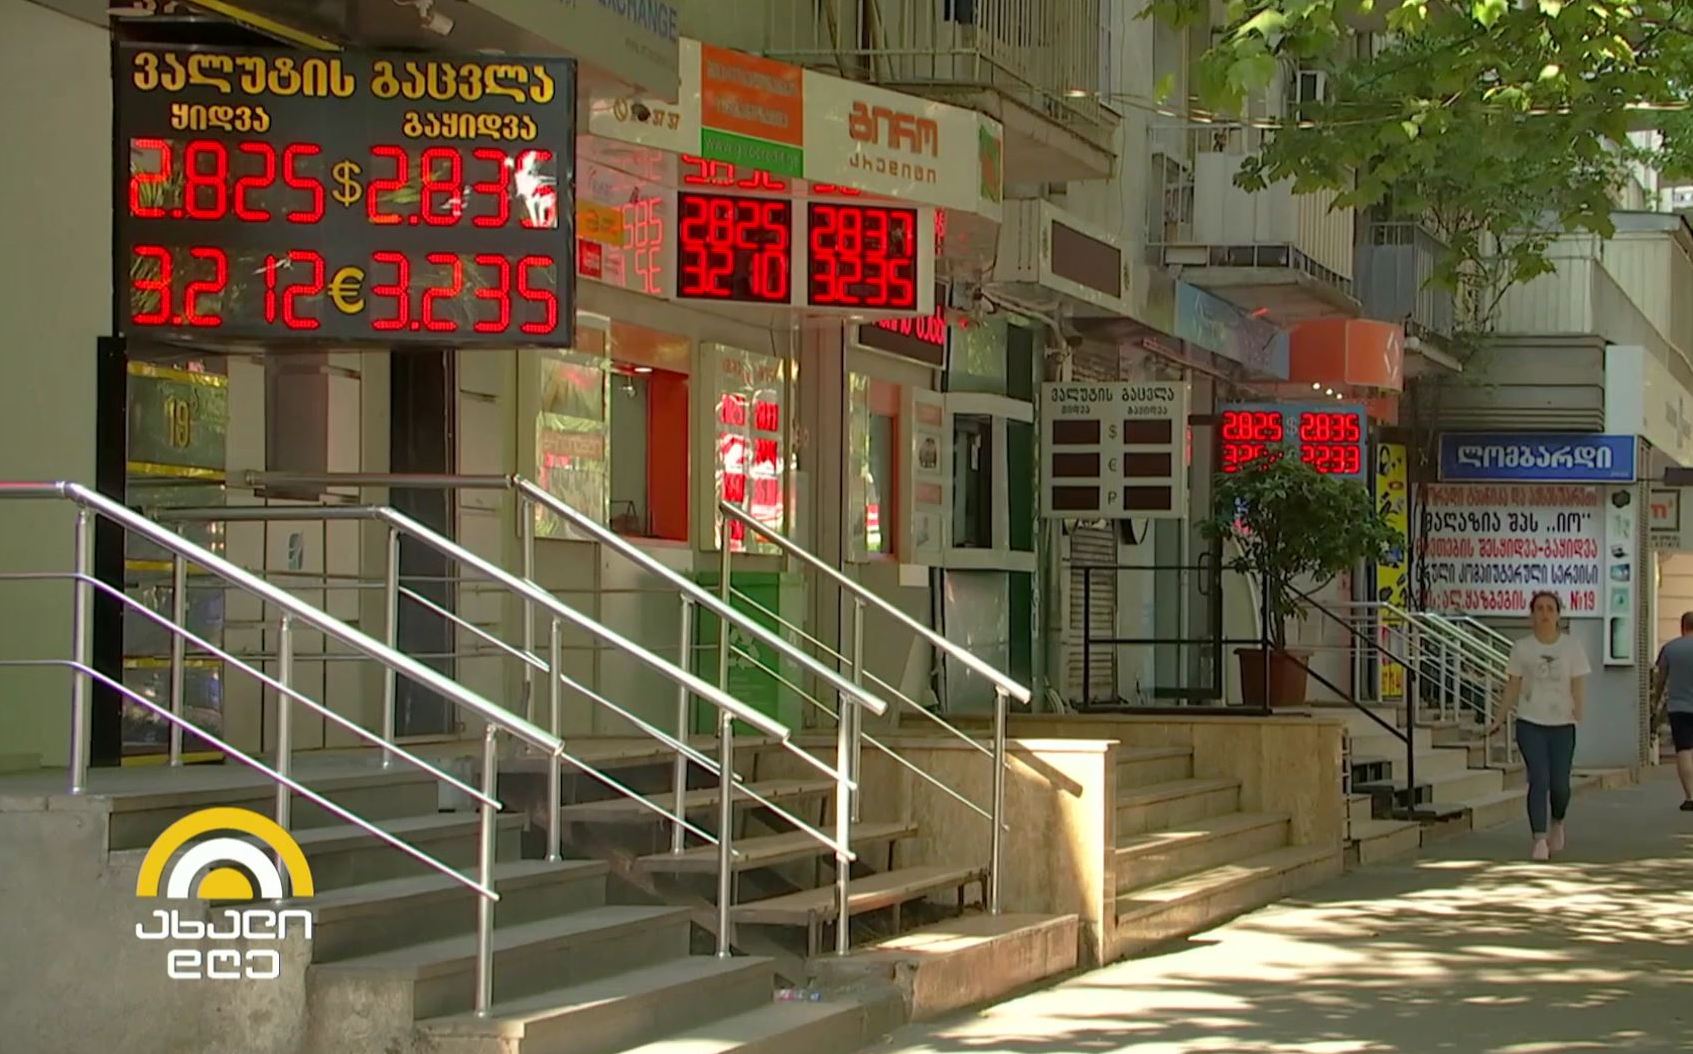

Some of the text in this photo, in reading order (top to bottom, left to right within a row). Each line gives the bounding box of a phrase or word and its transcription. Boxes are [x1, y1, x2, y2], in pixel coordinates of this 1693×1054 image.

[132, 51, 555, 104] ვალუტის გაცვლა
[170, 103, 271, 132] ყიდვა
[403, 112, 537, 140] გაყიდვა
[128, 137, 326, 224] 2.825
[129, 245, 326, 330] 3.212
[371, 251, 559, 335] 3.235
[1051, 387, 1175, 402] ვალუტის გაცვლა
[1457, 445, 1614, 469] ლომბარდი
[1508, 512, 1539, 533] შპს
